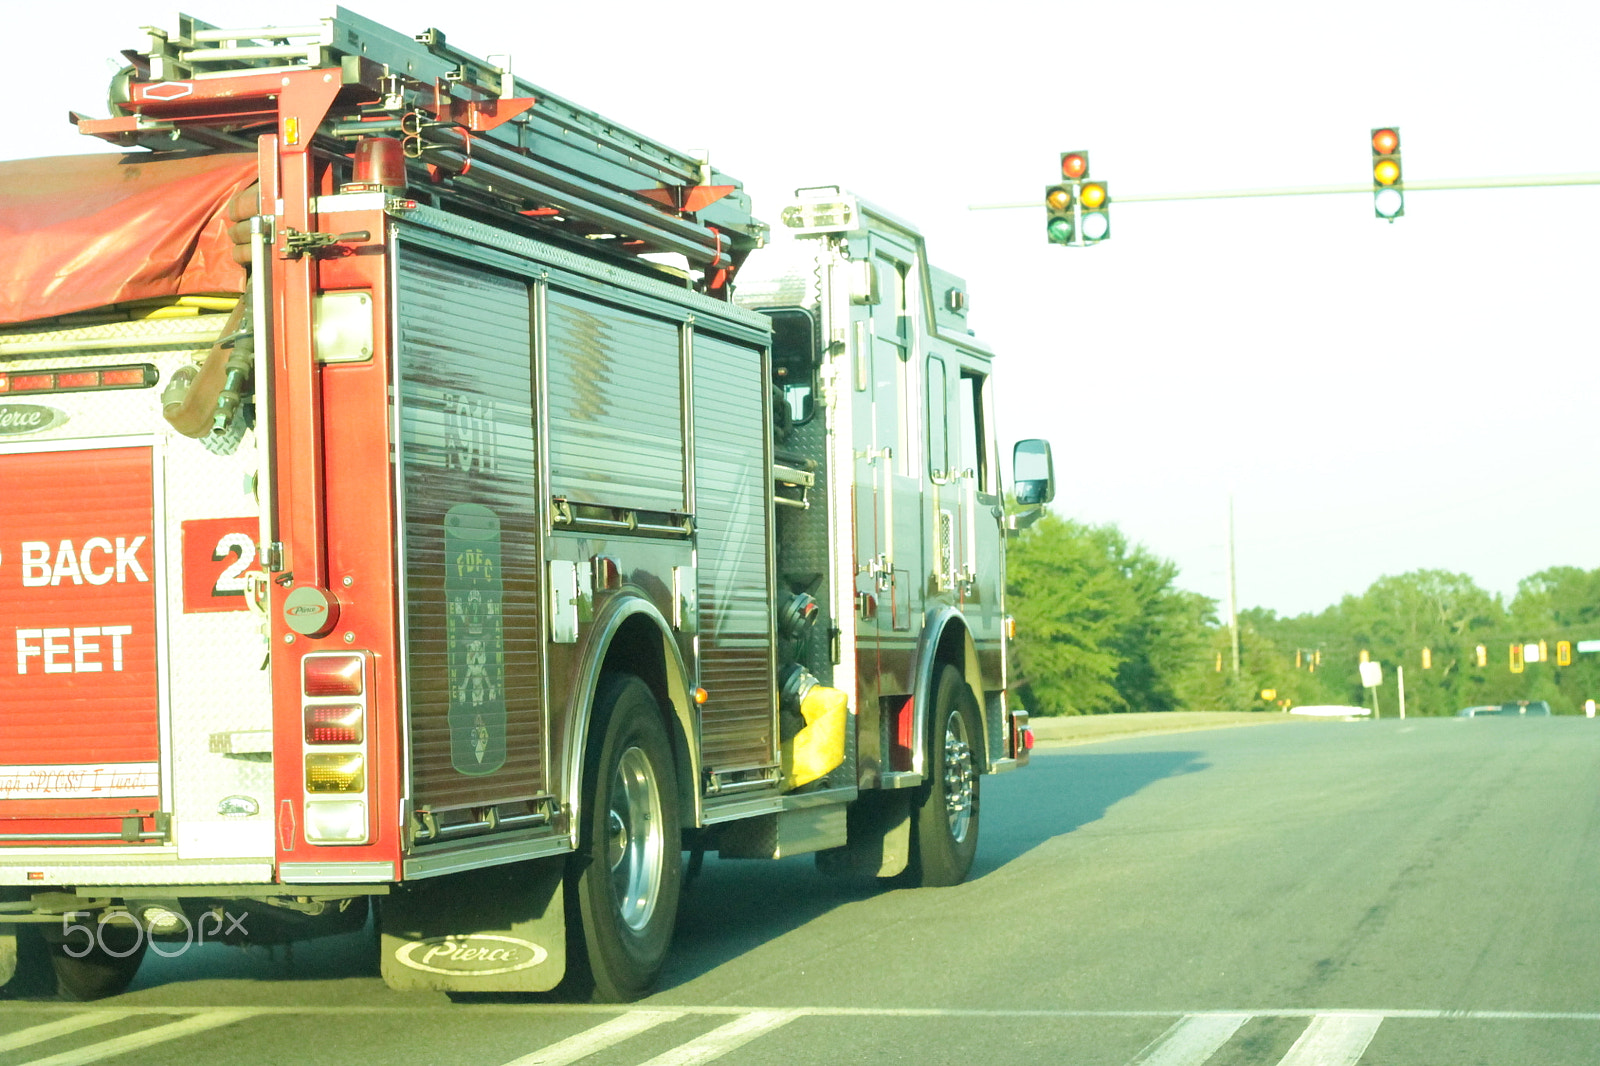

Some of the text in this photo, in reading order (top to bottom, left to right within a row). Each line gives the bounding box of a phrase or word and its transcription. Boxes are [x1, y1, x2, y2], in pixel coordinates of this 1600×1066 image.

[0, 408, 41, 427] ierce
[456, 395, 495, 474] 911
[21, 536, 149, 587] BACK
[16, 625, 132, 675] FEET
[422, 941, 519, 964] Pierce
